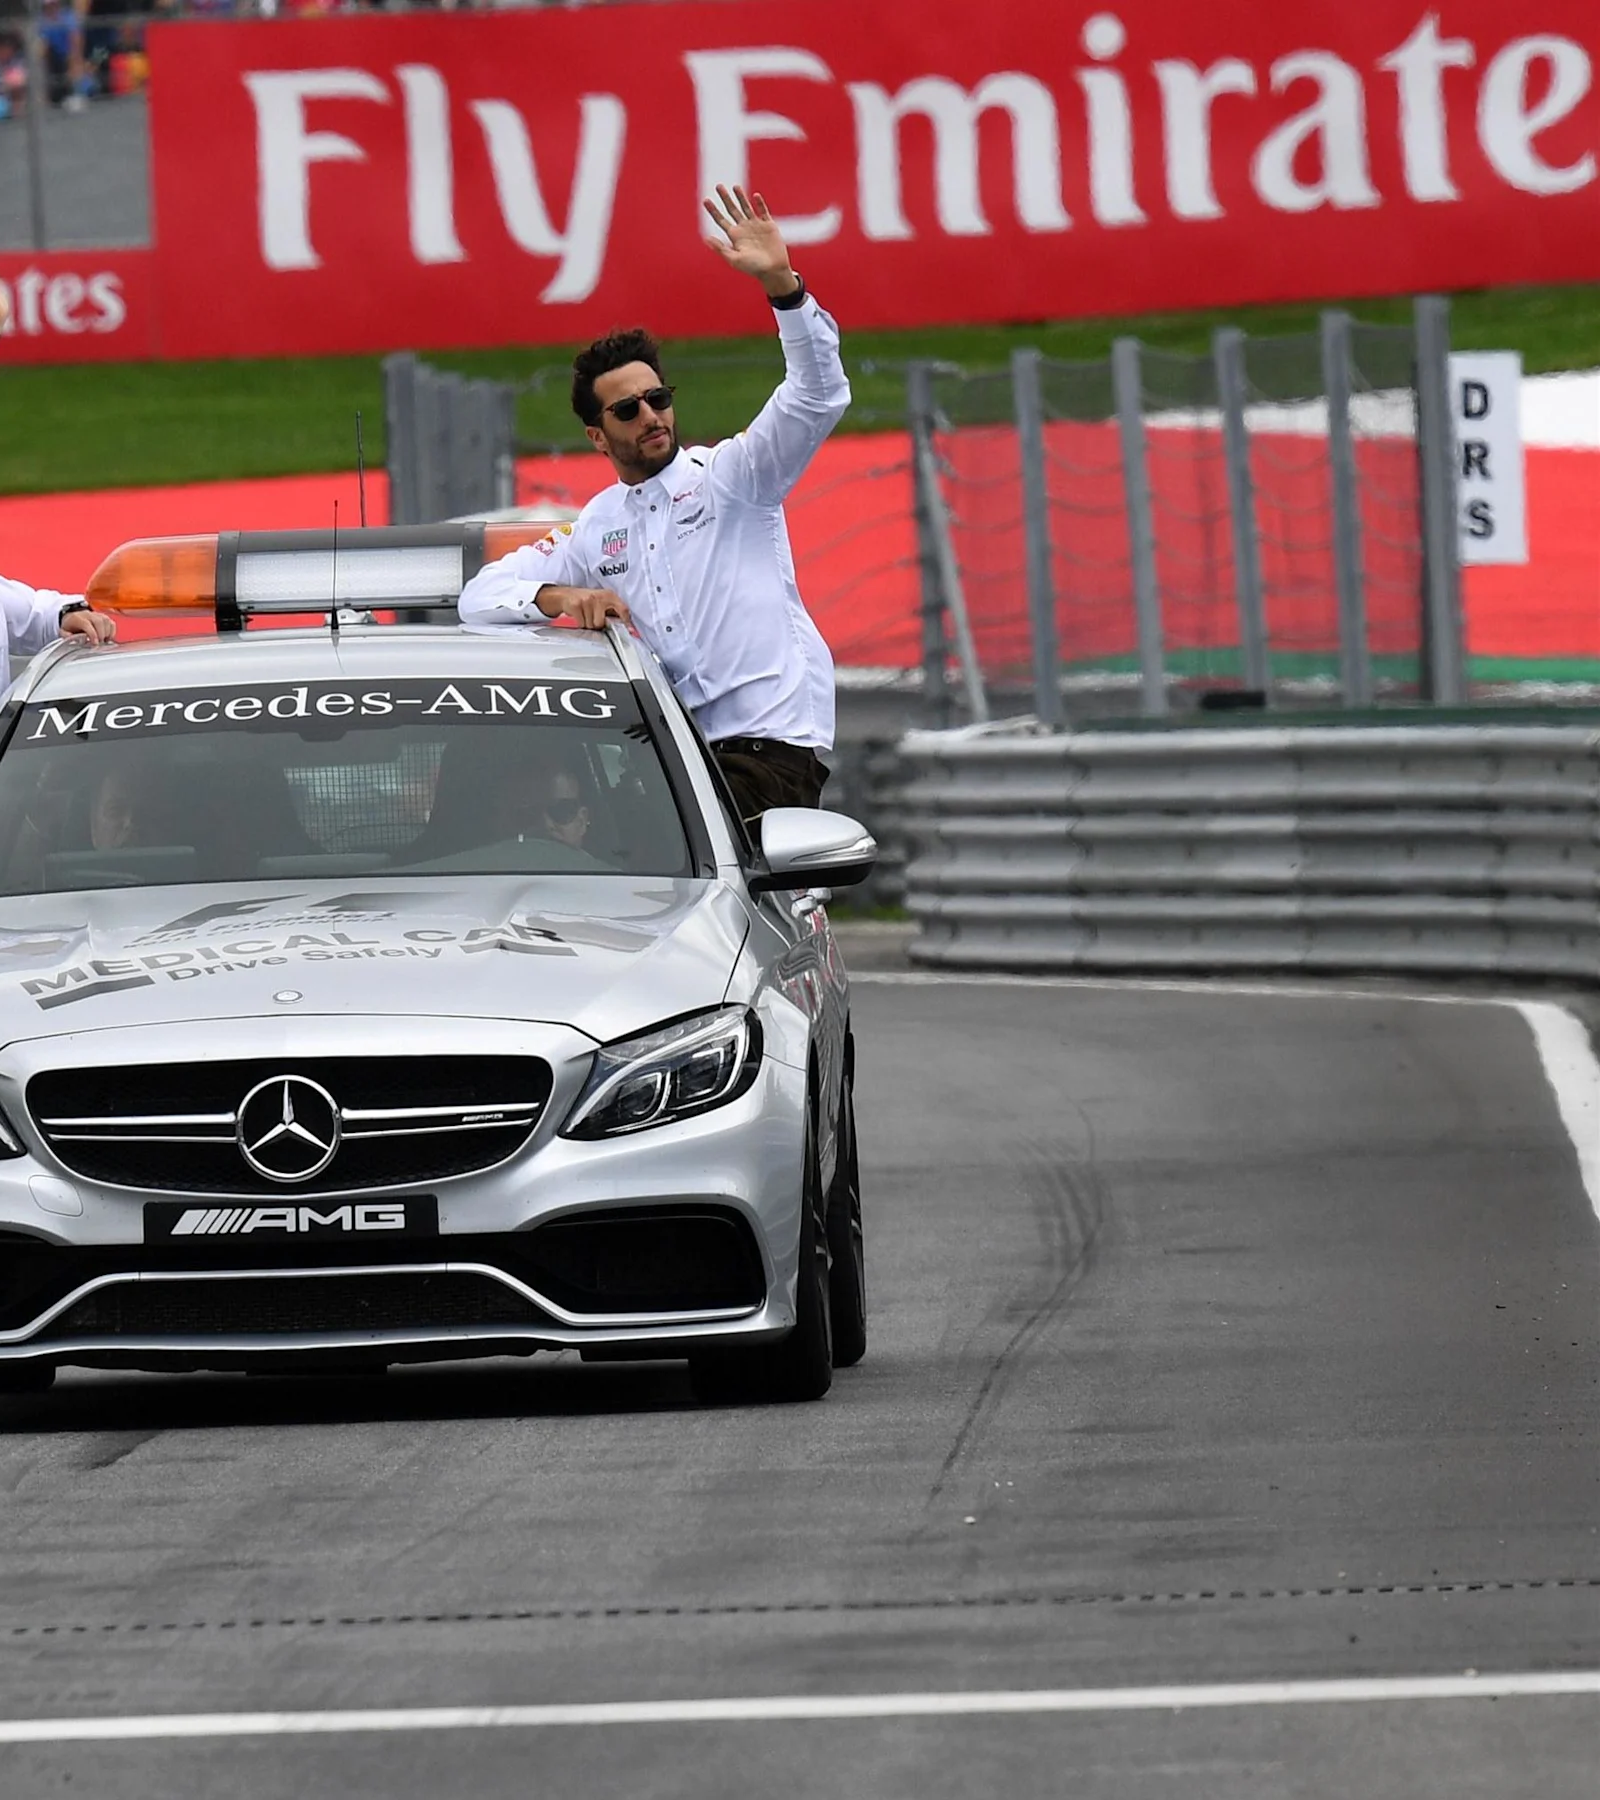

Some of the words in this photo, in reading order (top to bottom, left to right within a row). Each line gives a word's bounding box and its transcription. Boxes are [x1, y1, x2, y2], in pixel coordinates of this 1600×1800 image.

[244, 65, 627, 303] Fly
[686, 13, 1598, 242] Emirate
[1462, 380, 1495, 541] DRS
[603, 529, 627, 543] TAG
[26, 684, 617, 740] Mercedes-AMG
[20, 932, 380, 995] MEDICAL
[403, 921, 566, 943] CAR
[166, 956, 288, 981] Drive
[301, 946, 442, 961] Safely
